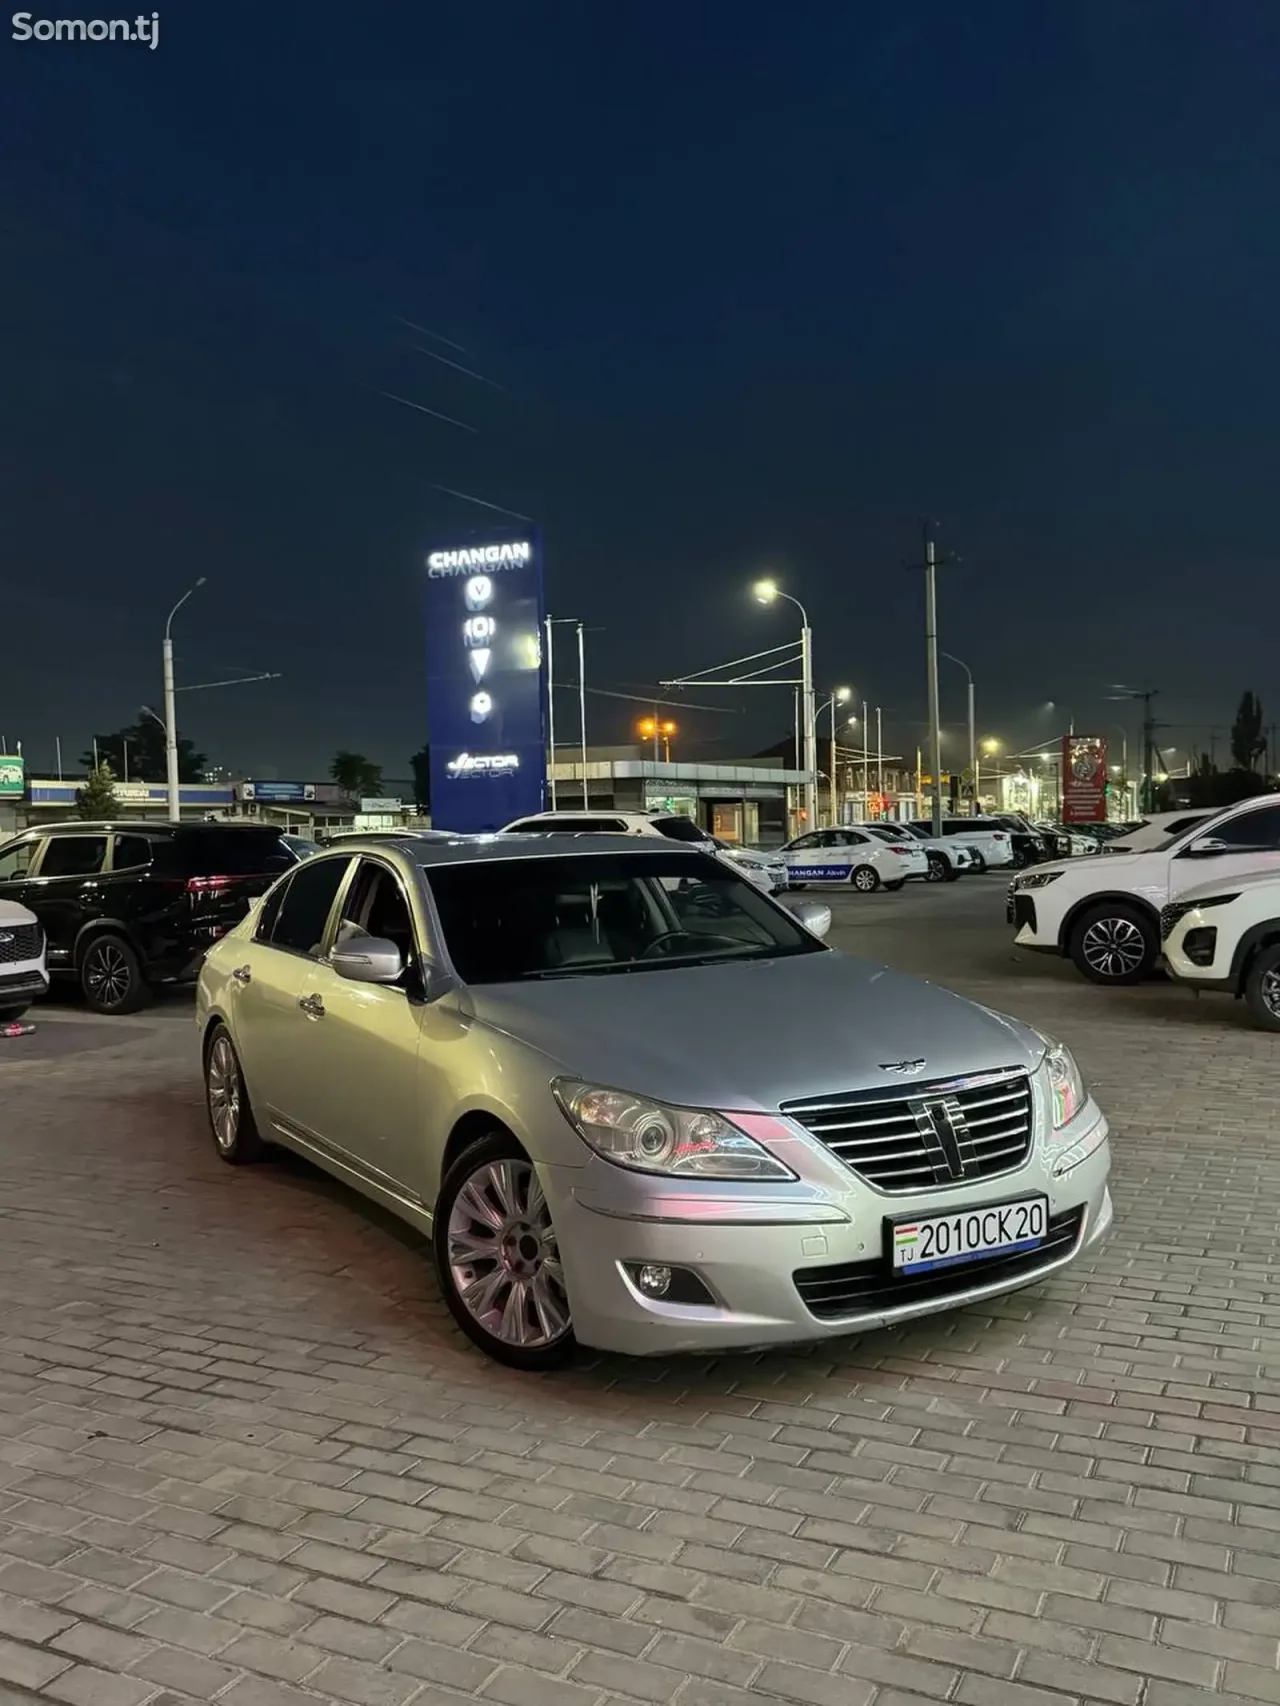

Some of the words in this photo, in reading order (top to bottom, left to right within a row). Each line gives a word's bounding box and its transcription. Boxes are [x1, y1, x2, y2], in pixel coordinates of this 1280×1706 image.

[427, 541, 530, 570] CHANGAN
[919, 1203, 1043, 1259] 2010CK20
[900, 1247, 915, 1262] TJ
